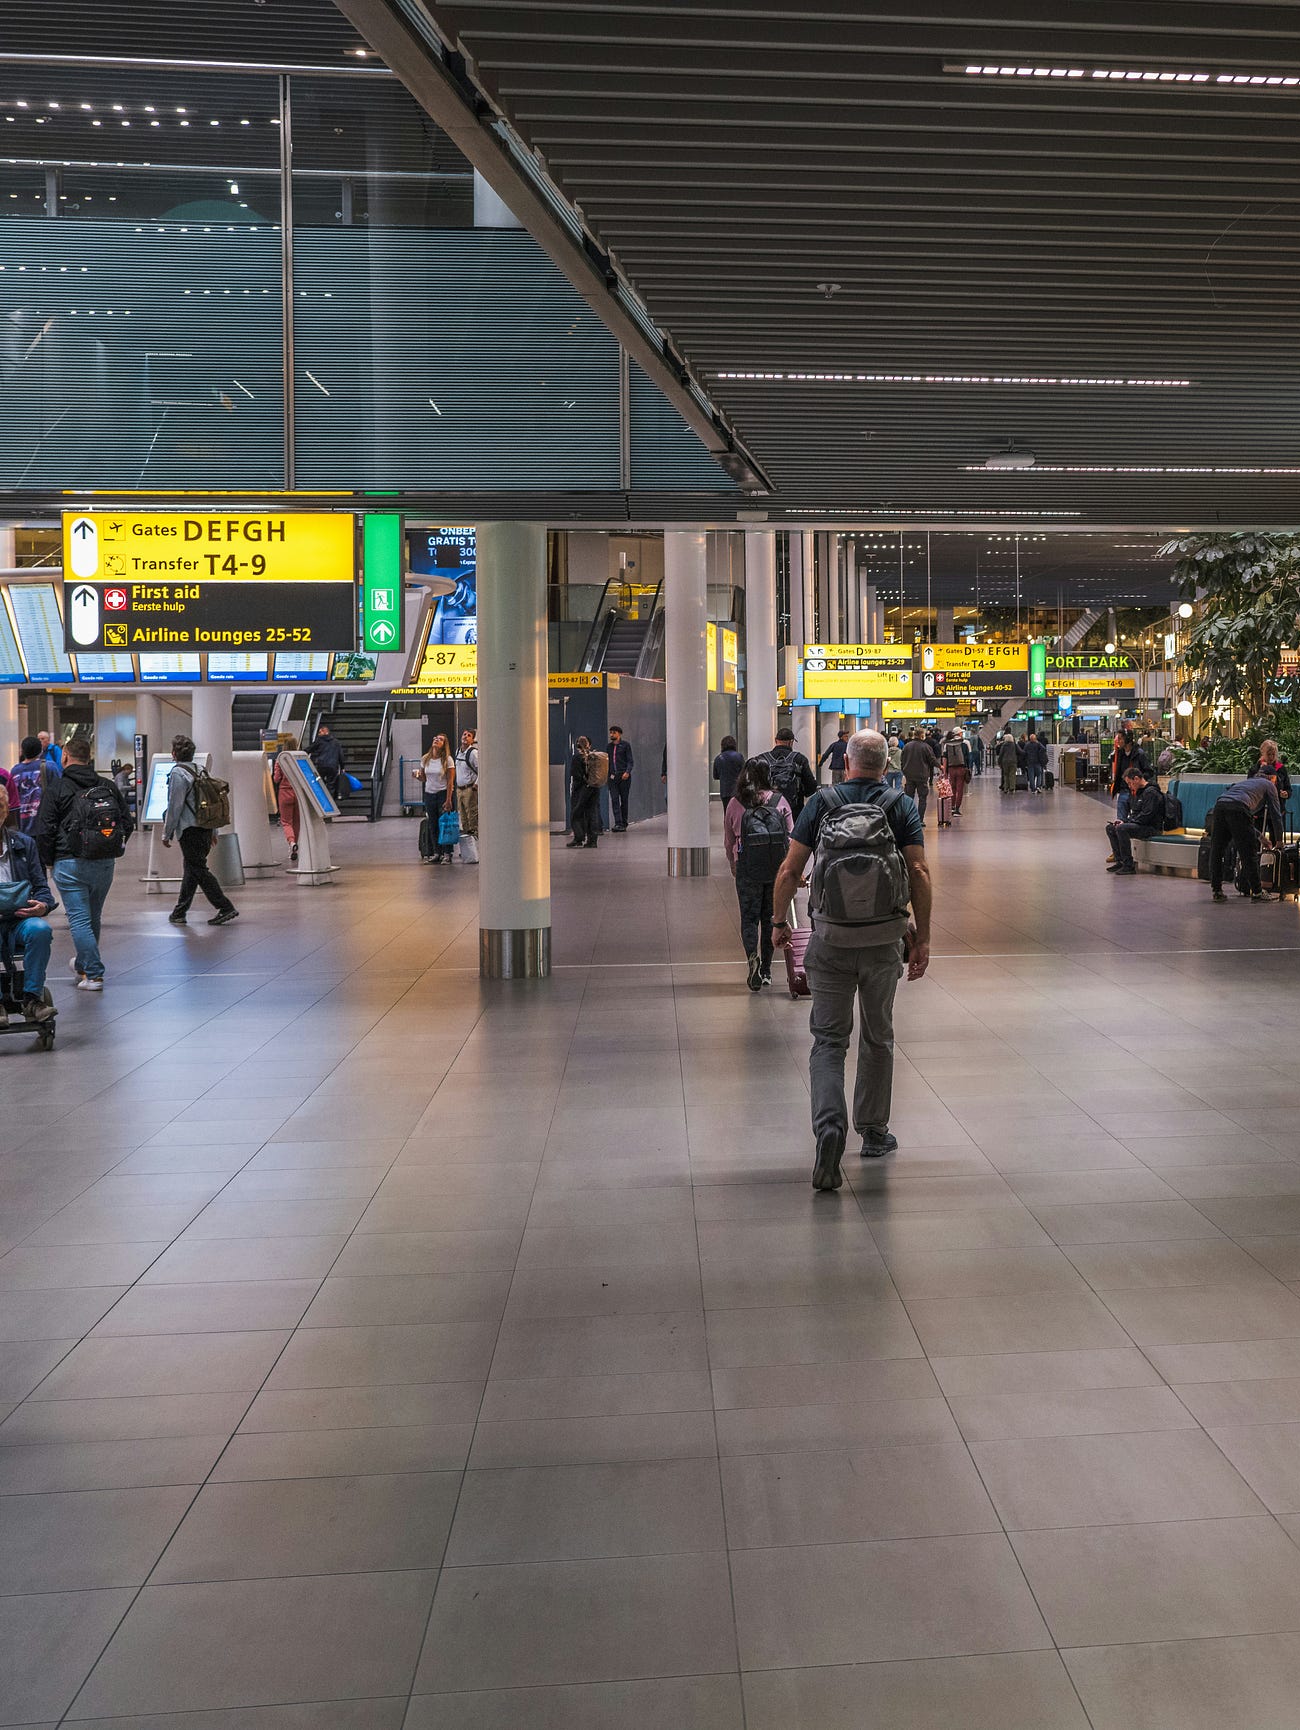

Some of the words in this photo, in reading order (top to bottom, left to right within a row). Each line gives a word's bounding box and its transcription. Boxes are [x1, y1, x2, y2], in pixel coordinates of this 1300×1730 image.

[132, 523, 177, 537] Gates
[184, 520, 286, 542] DEFGH
[428, 537, 466, 546] GRATIS
[468, 537, 476, 546] T
[132, 557, 199, 570] Transfer
[204, 554, 266, 575] T4-9
[132, 585, 170, 599] First
[175, 585, 200, 599] aid
[132, 602, 162, 611] Eerste
[163, 601, 185, 613] hulp
[132, 628, 190, 642] Airline
[195, 628, 261, 645] lounges
[266, 628, 312, 642] 25-52
[972, 660, 996, 668] T4-9
[1046, 656, 1084, 668] PORT
[1089, 656, 1129, 668] PARK
